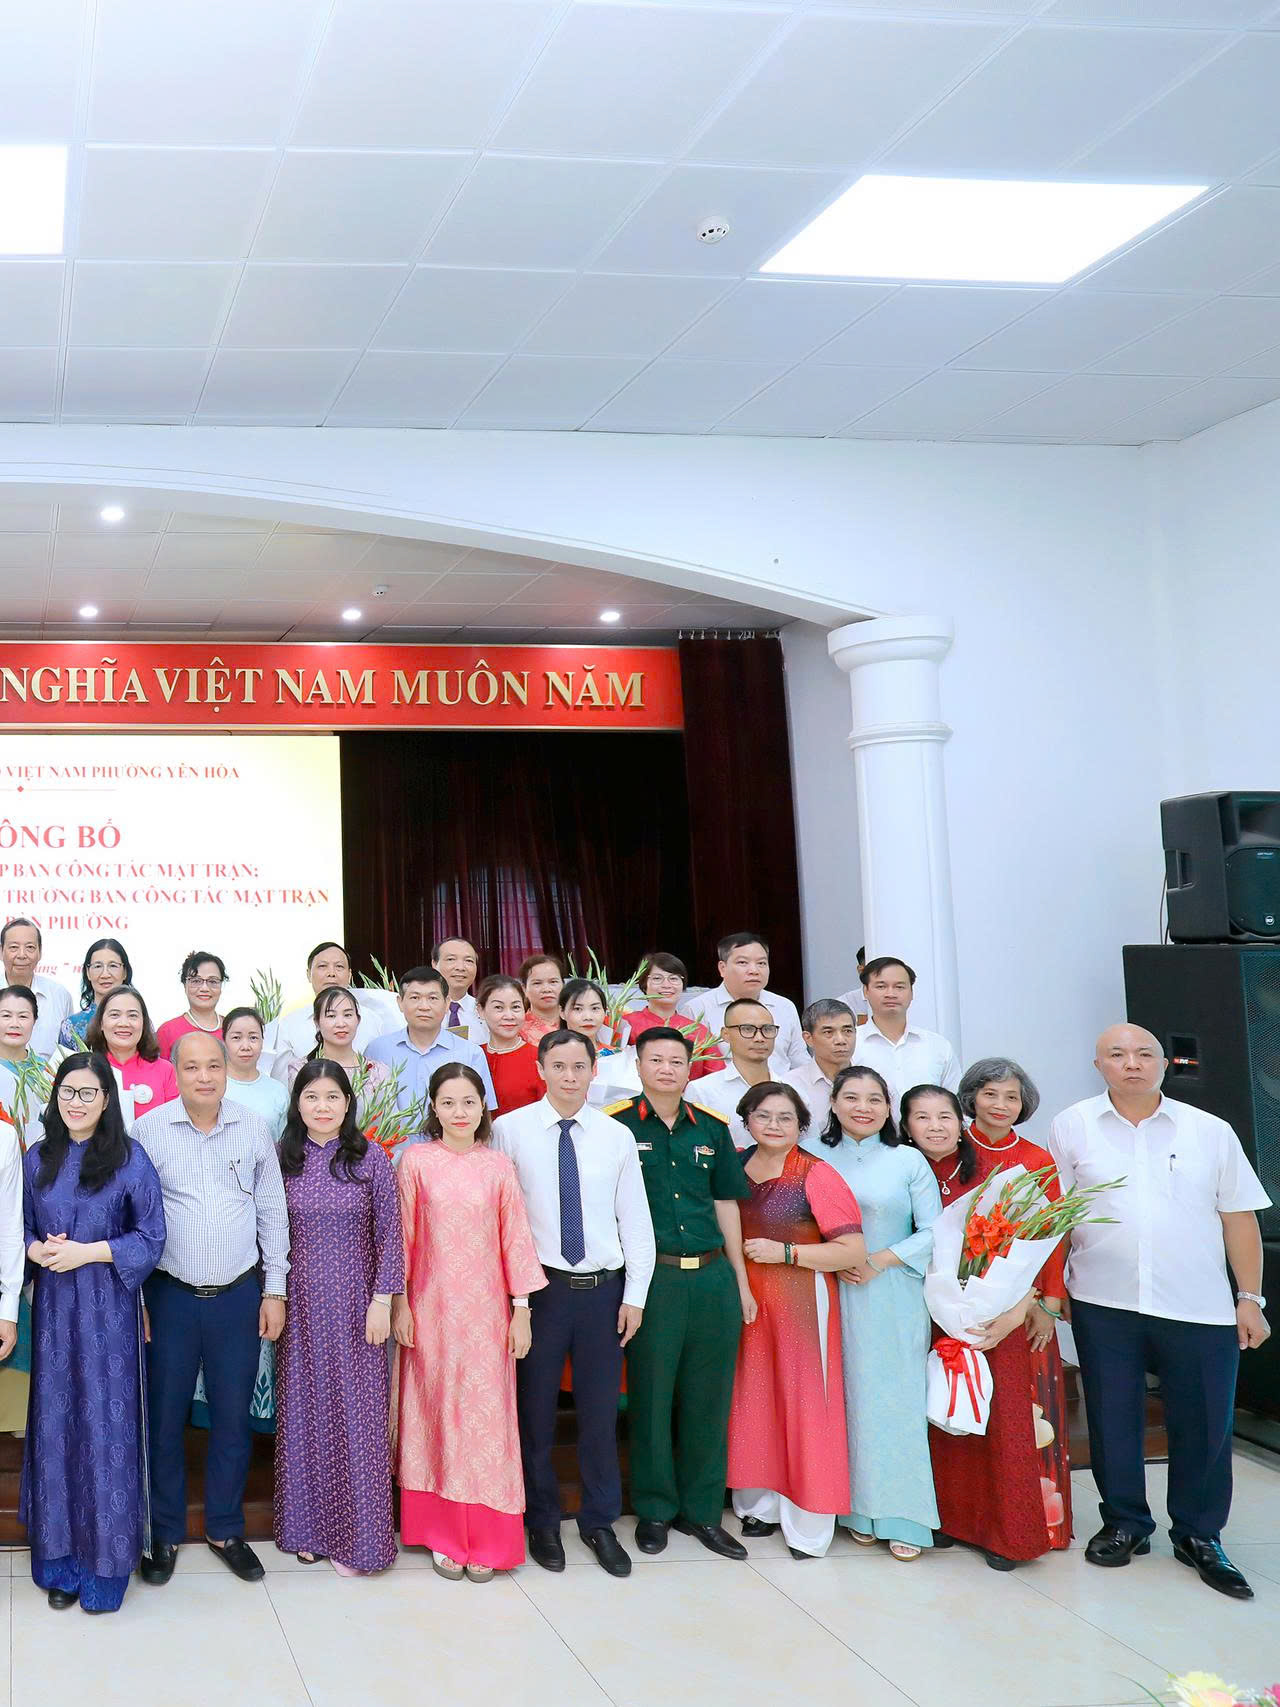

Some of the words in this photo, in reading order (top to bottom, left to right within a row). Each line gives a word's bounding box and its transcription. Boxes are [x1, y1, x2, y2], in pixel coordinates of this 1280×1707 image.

[0, 657, 150, 703] NGHĨA
[152, 656, 263, 713] VIỆT
[275, 668, 377, 704] NAM
[390, 658, 531, 706] MUÔN
[545, 664, 646, 708] NĂM
[49, 766, 86, 778] NAM
[77, 818, 122, 849] BỐ
[14, 863, 49, 878] BAN
[55, 858, 110, 878] CÔNG
[90, 889, 127, 904] BAN
[132, 884, 185, 904] CÔNG
